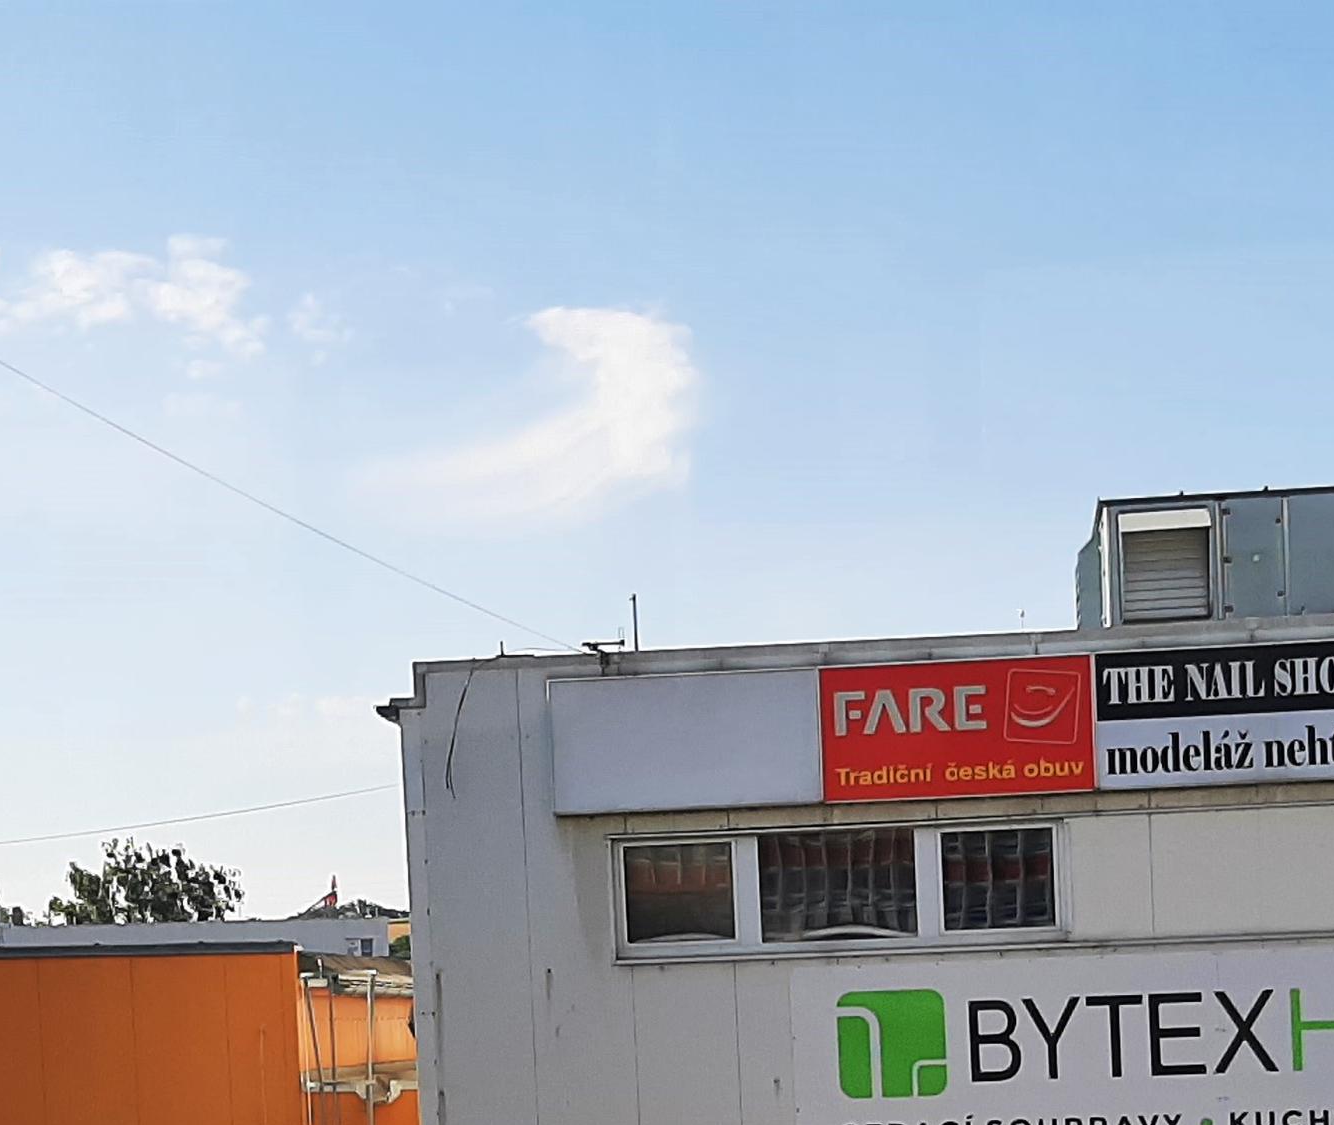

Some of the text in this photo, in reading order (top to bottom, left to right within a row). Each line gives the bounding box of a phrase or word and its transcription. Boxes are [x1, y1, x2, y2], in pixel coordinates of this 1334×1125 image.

[1102, 665, 1175, 705] THE
[1184, 660, 1265, 701] NAIL
[833, 685, 987, 737] FARE
[835, 757, 1084, 786] Tradiční česká obuv
[1106, 729, 1254, 775] modeláž
